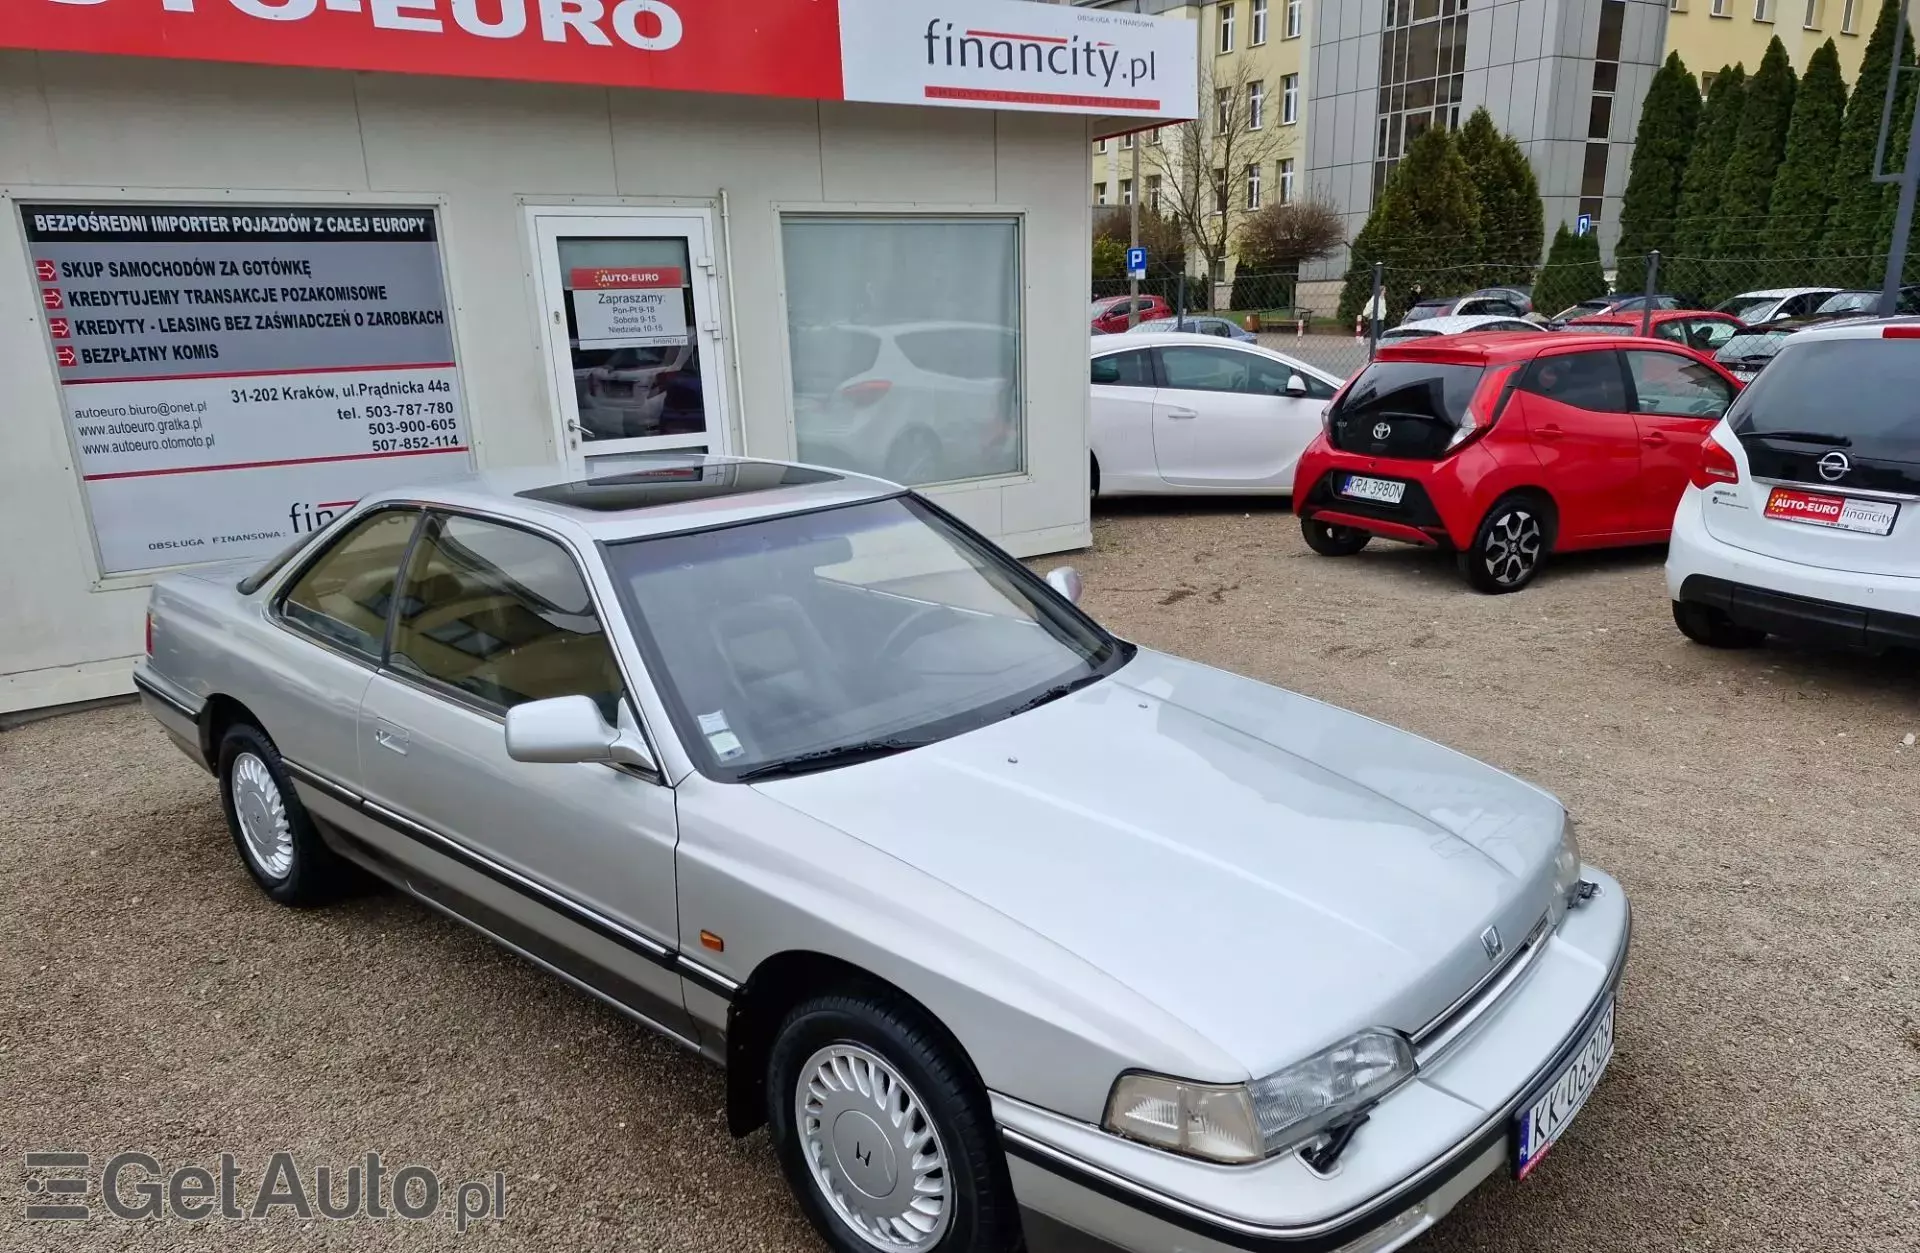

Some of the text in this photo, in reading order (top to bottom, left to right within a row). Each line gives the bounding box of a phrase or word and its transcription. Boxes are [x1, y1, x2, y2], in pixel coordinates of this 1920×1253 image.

[924, 18, 1156, 88] financity.pl
[34, 211, 425, 233] BEZPOŚREDNI IMPORTER POJAZDÓW Z CAŁEJ EUROPY
[61, 257, 312, 279] SKUP SAMOCHODÓW ZA GOTÓWKĘ
[1131, 250, 1142, 268] P
[601, 273, 659, 282] AUTO-EURO
[68, 285, 388, 307] KREDYTUJEMY TRANSAKCJE POZAKOMISOWE
[74, 319, 145, 336] KREDYTY
[158, 317, 221, 333] LEASING
[225, 315, 252, 331] BEZ
[255, 309, 351, 330] ZAŚWIADCZEŃ
[354, 312, 364, 327] O
[367, 310, 444, 326] ZAROBKACH
[81, 344, 219, 364] BEZPŁATNY KOMIS
[231, 379, 450, 403] 31-202 Kraków, ul.Prądnicka 44a
[74, 401, 207, 419] autoeuro.biuro@onet.pl
[337, 402, 454, 420] tel. 503-787-780
[78, 416, 203, 437] www.autoeuro.gratka.pl
[368, 418, 457, 435] 503-900-605
[83, 434, 216, 455] www.autoeuro.otomoto.pl
[372, 435, 459, 452] 507-852-114
[1350, 478, 1403, 499] KRA 3980N
[1774, 498, 1839, 515] AUTO-EURO
[1842, 506, 1893, 526] financity
[148, 530, 287, 551] OBSŁUGA FINANSOWA:
[1534, 1082, 1560, 1149] KK
